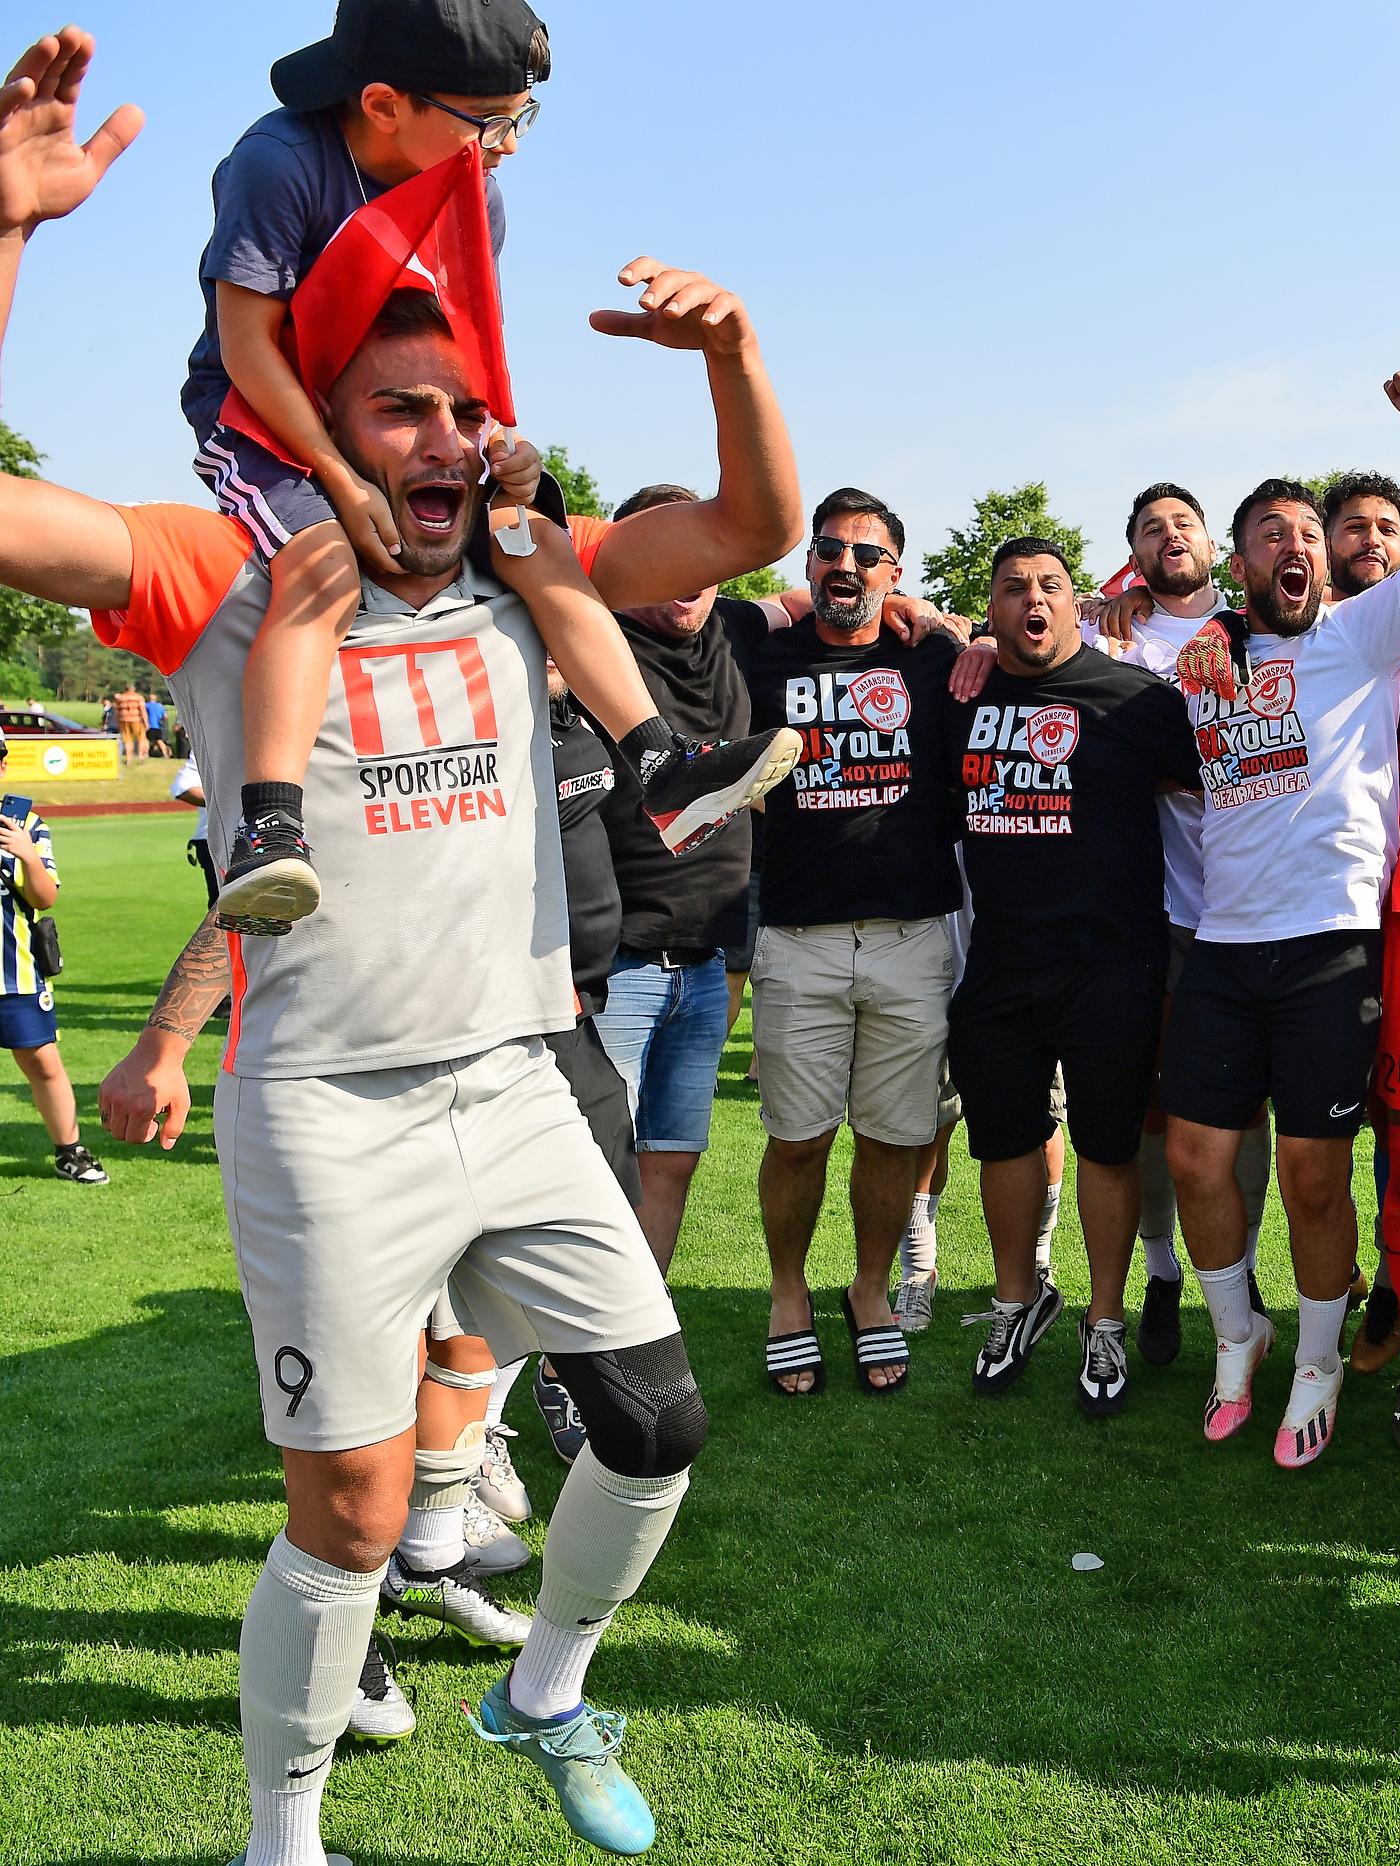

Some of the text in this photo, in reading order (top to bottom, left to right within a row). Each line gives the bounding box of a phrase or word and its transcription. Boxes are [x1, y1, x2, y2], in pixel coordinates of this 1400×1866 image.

[786, 672, 860, 724] BIZ
[855, 676, 895, 693] VATANSPOR
[967, 706, 1030, 750] BIZ
[1032, 712, 1071, 727] VATANSPOR
[1219, 712, 1304, 755] YOLA
[824, 729, 912, 760] YOLA
[843, 762, 911, 782] KOYDUK
[995, 761, 1073, 789] YOLA
[1241, 748, 1307, 775] KOYDUK
[359, 754, 498, 799] SPORTSBAR
[1212, 772, 1310, 809] BEZIRKSLIGA
[364, 789, 506, 835] ELEVEN
[797, 785, 909, 810] BEZIRKSLIGA
[1004, 794, 1071, 811] KOYDUK
[966, 815, 1072, 833] BEZIRKSLIGA
[275, 1346, 313, 1417] 9
